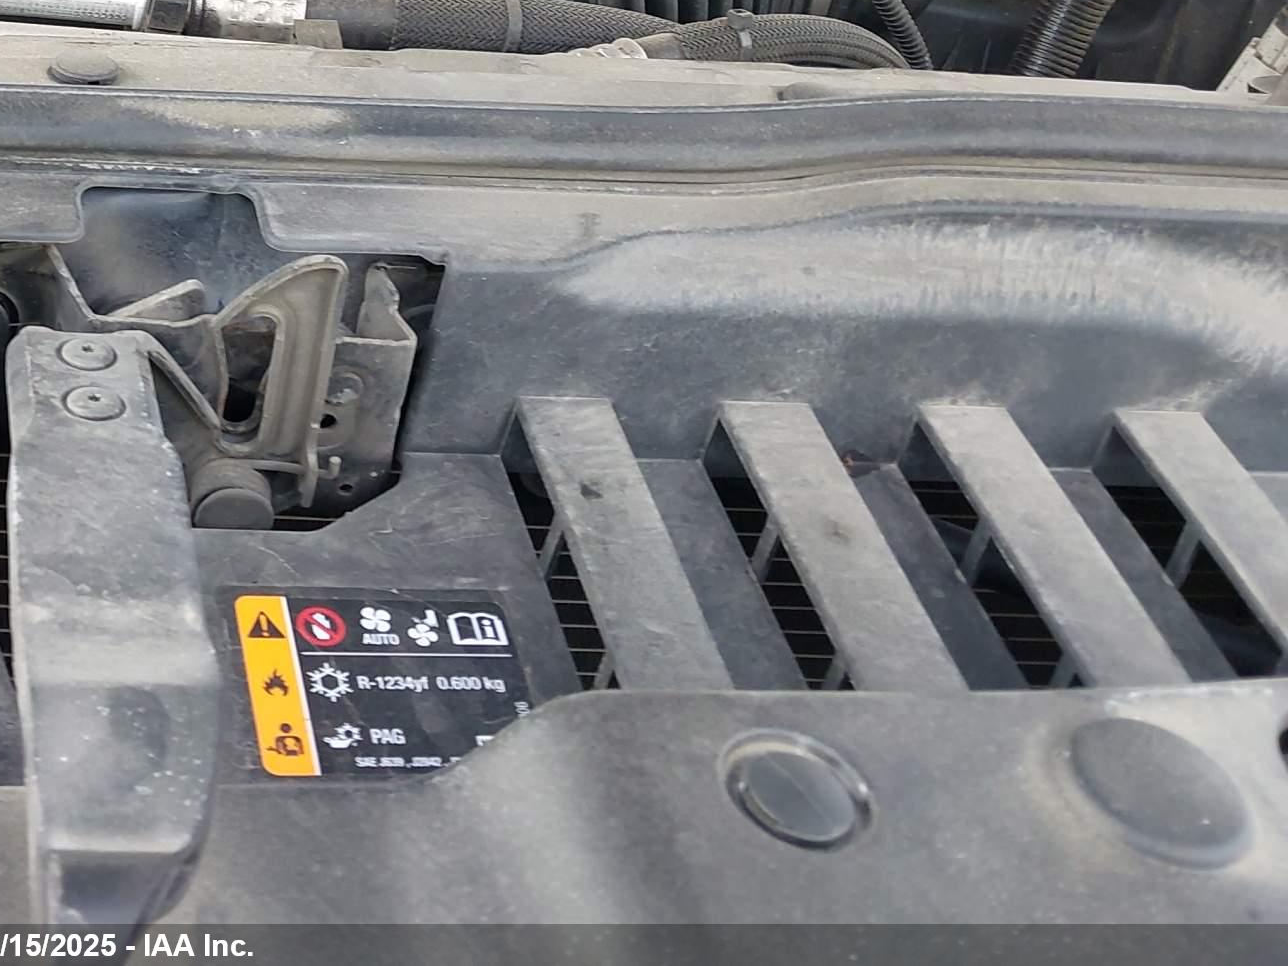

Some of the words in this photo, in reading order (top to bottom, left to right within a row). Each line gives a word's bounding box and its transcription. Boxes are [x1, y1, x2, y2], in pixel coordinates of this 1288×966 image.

[362, 633, 400, 646] AUTO
[355, 675, 429, 693] R-1234yf
[435, 675, 482, 691] 0.600
[483, 676, 507, 693] kg
[370, 728, 406, 745] PAG
